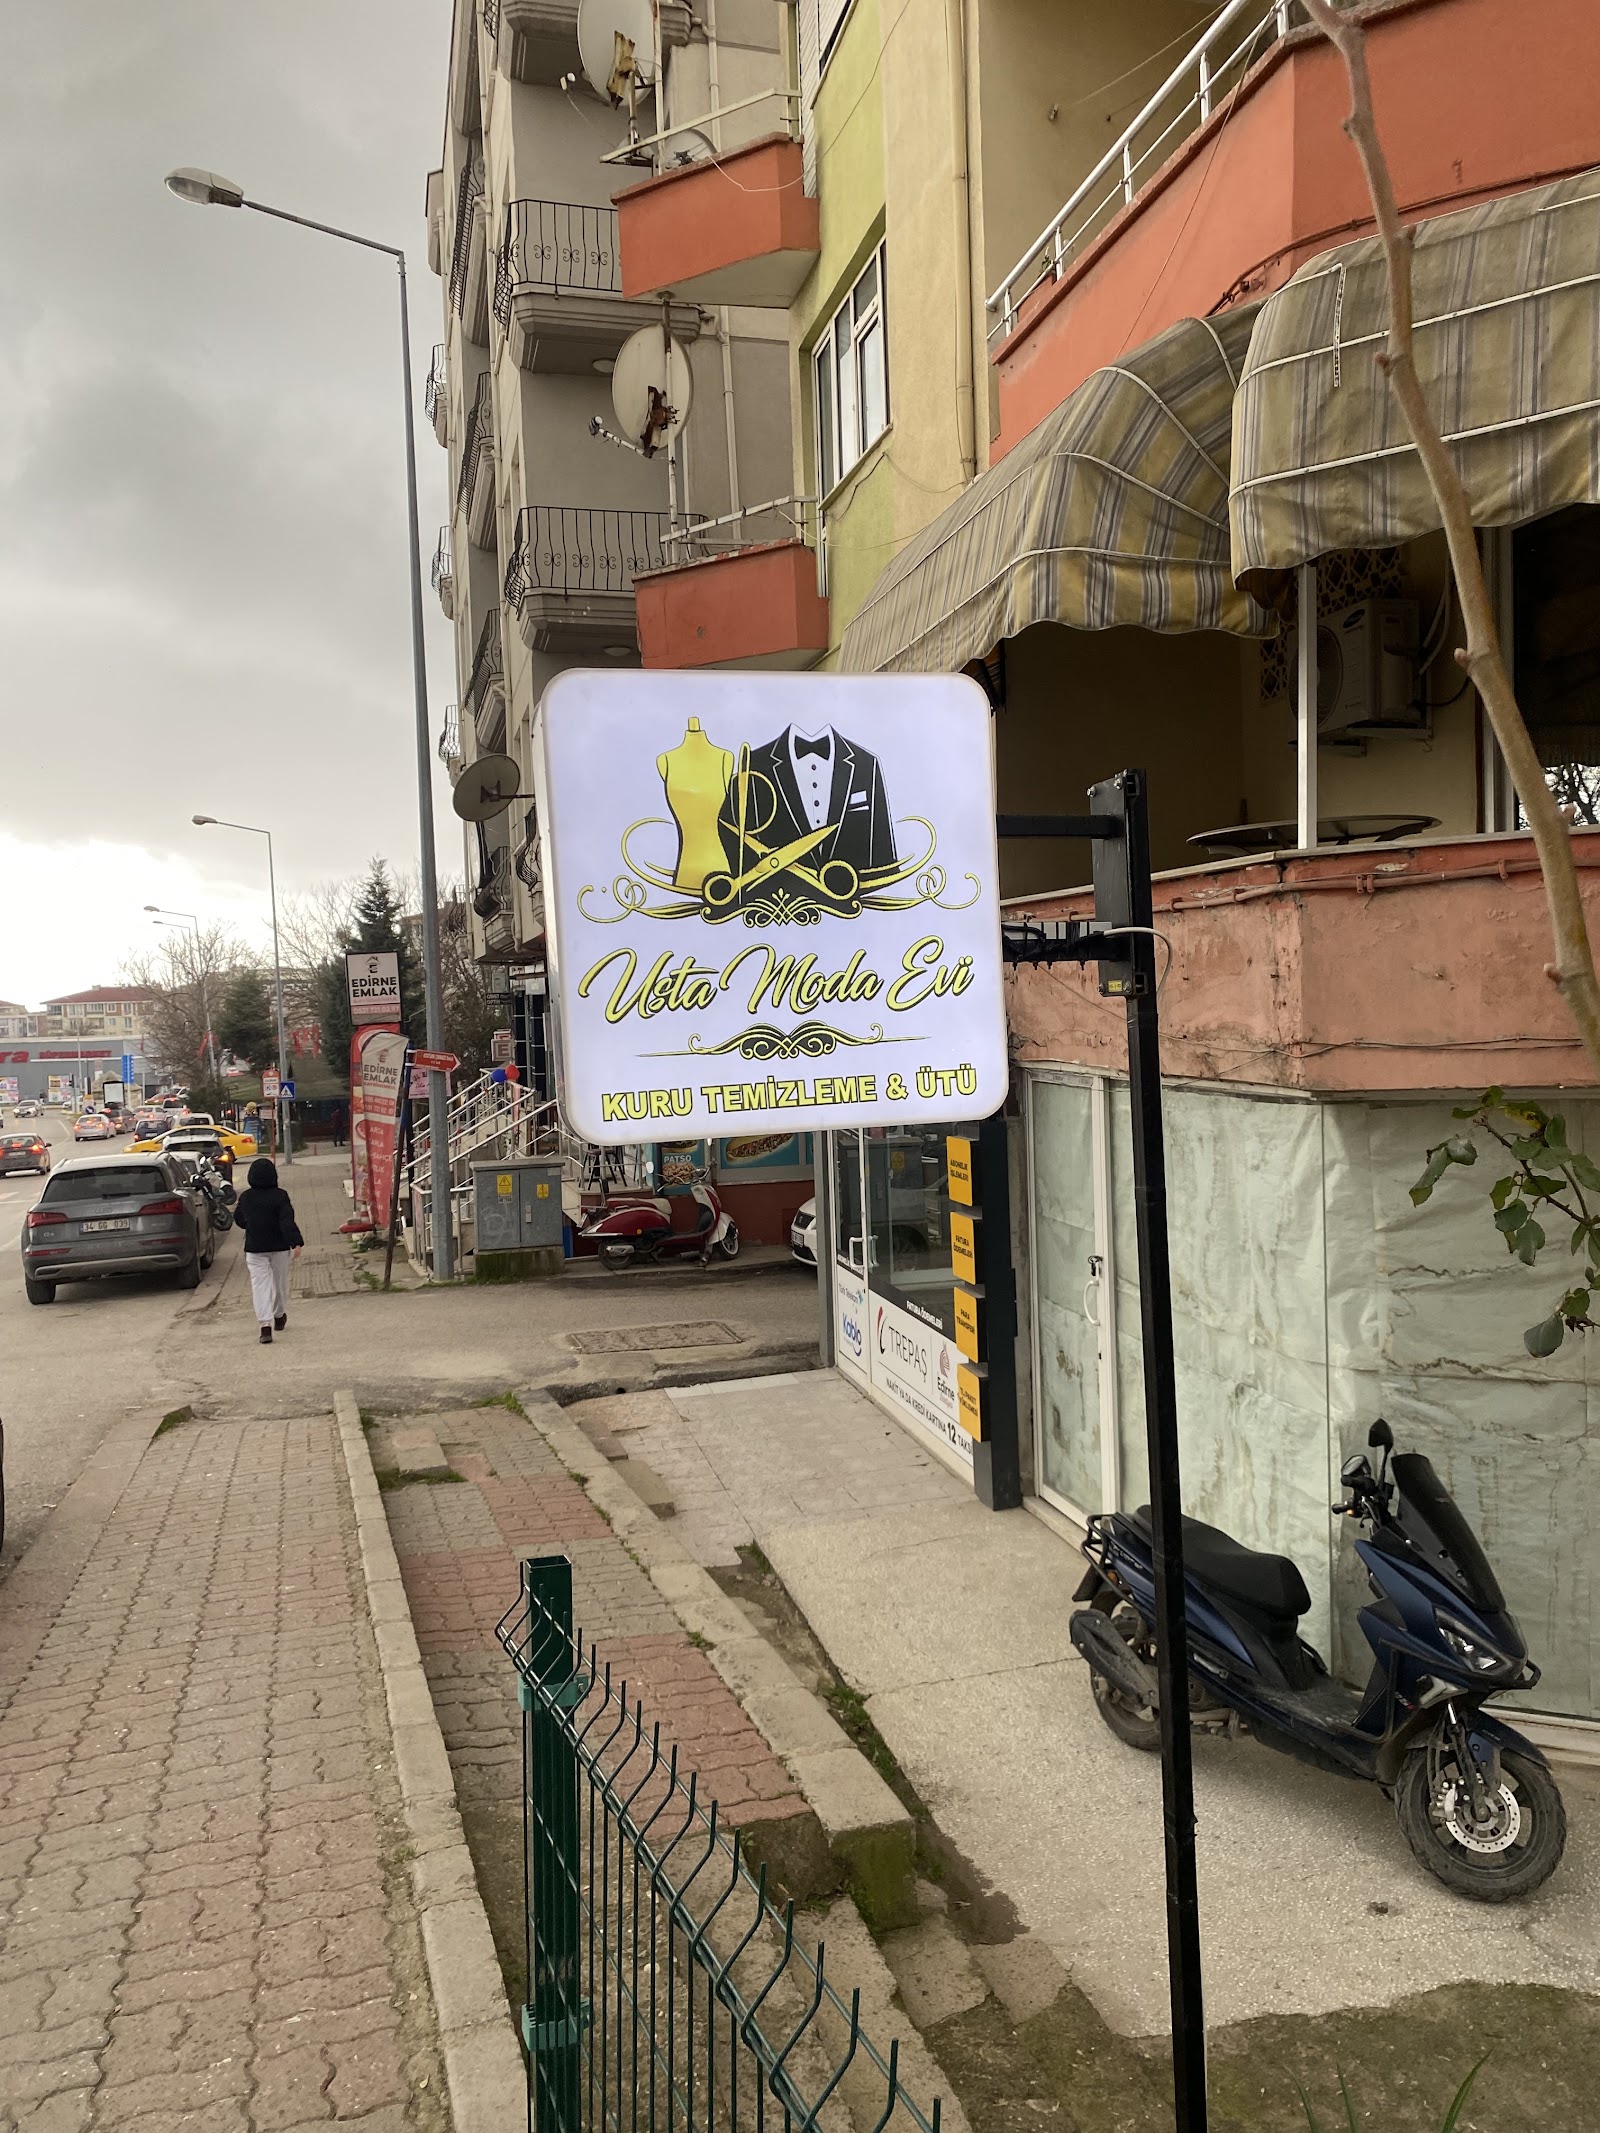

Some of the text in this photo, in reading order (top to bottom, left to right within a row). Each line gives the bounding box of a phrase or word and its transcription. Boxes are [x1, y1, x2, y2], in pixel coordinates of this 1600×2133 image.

[351, 975, 397, 988] EDİRNE
[578, 935, 975, 1024] Usta Moda Evi
[352, 987, 398, 998] EMLAK
[363, 1064, 398, 1077] EDİRNE
[363, 1073, 397, 1085] EMLAK
[602, 1063, 978, 1122] KURU TEMİZLEME & ÜTÜ
[663, 1154, 692, 1164] PATSO
[84, 1222, 94, 1231] 34
[842, 1311, 862, 1346] Kablo
[888, 1325, 928, 1383] TREPAŞ
[937, 1375, 955, 1402] Edirne
[886, 1377, 899, 1395] NAKİT
[899, 1387, 905, 1399] YA
[905, 1392, 912, 1405] DA
[912, 1398, 926, 1417] KREDİ
[926, 1409, 947, 1434] KARTINA
[947, 1422, 957, 1445] 12
